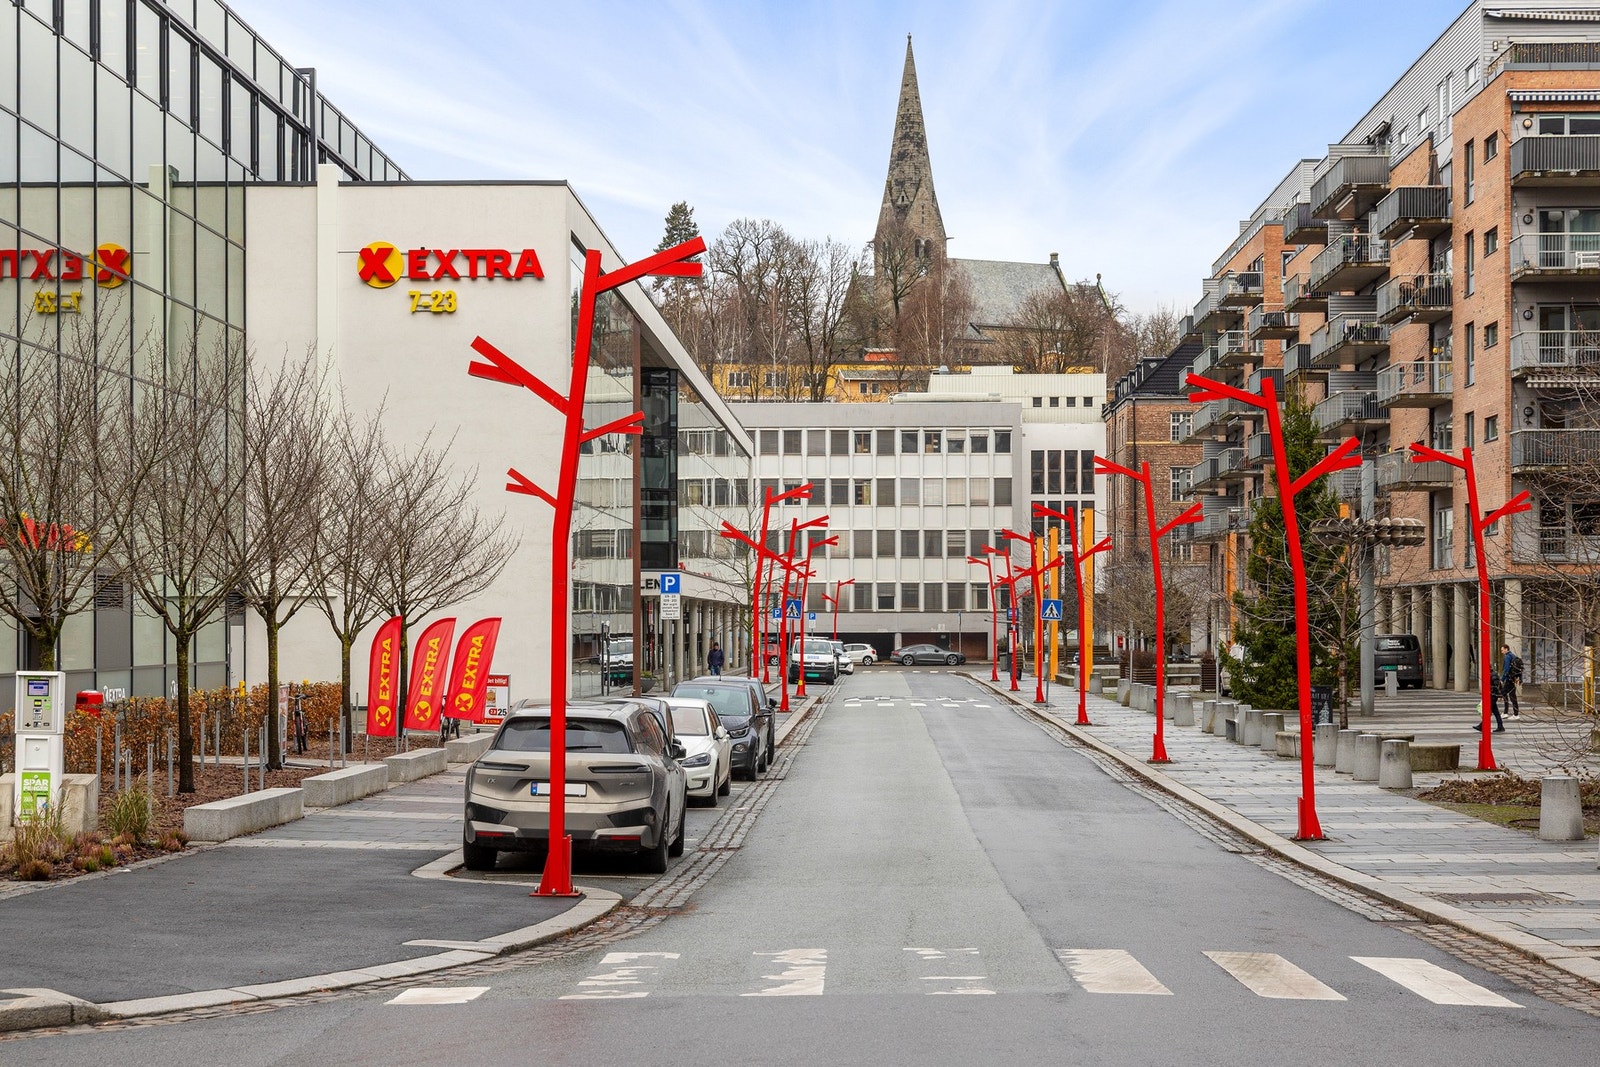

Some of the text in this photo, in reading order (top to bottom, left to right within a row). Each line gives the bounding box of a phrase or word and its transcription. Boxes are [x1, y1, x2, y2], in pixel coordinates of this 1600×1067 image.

[408, 249, 545, 279] EXTRA
[408, 290, 458, 313] 7-23
[665, 577, 676, 591] P
[379, 638, 392, 700] EXTRA
[421, 637, 440, 696] EXTRA
[462, 635, 484, 689] EXTRA
[497, 708, 507, 716] 25
